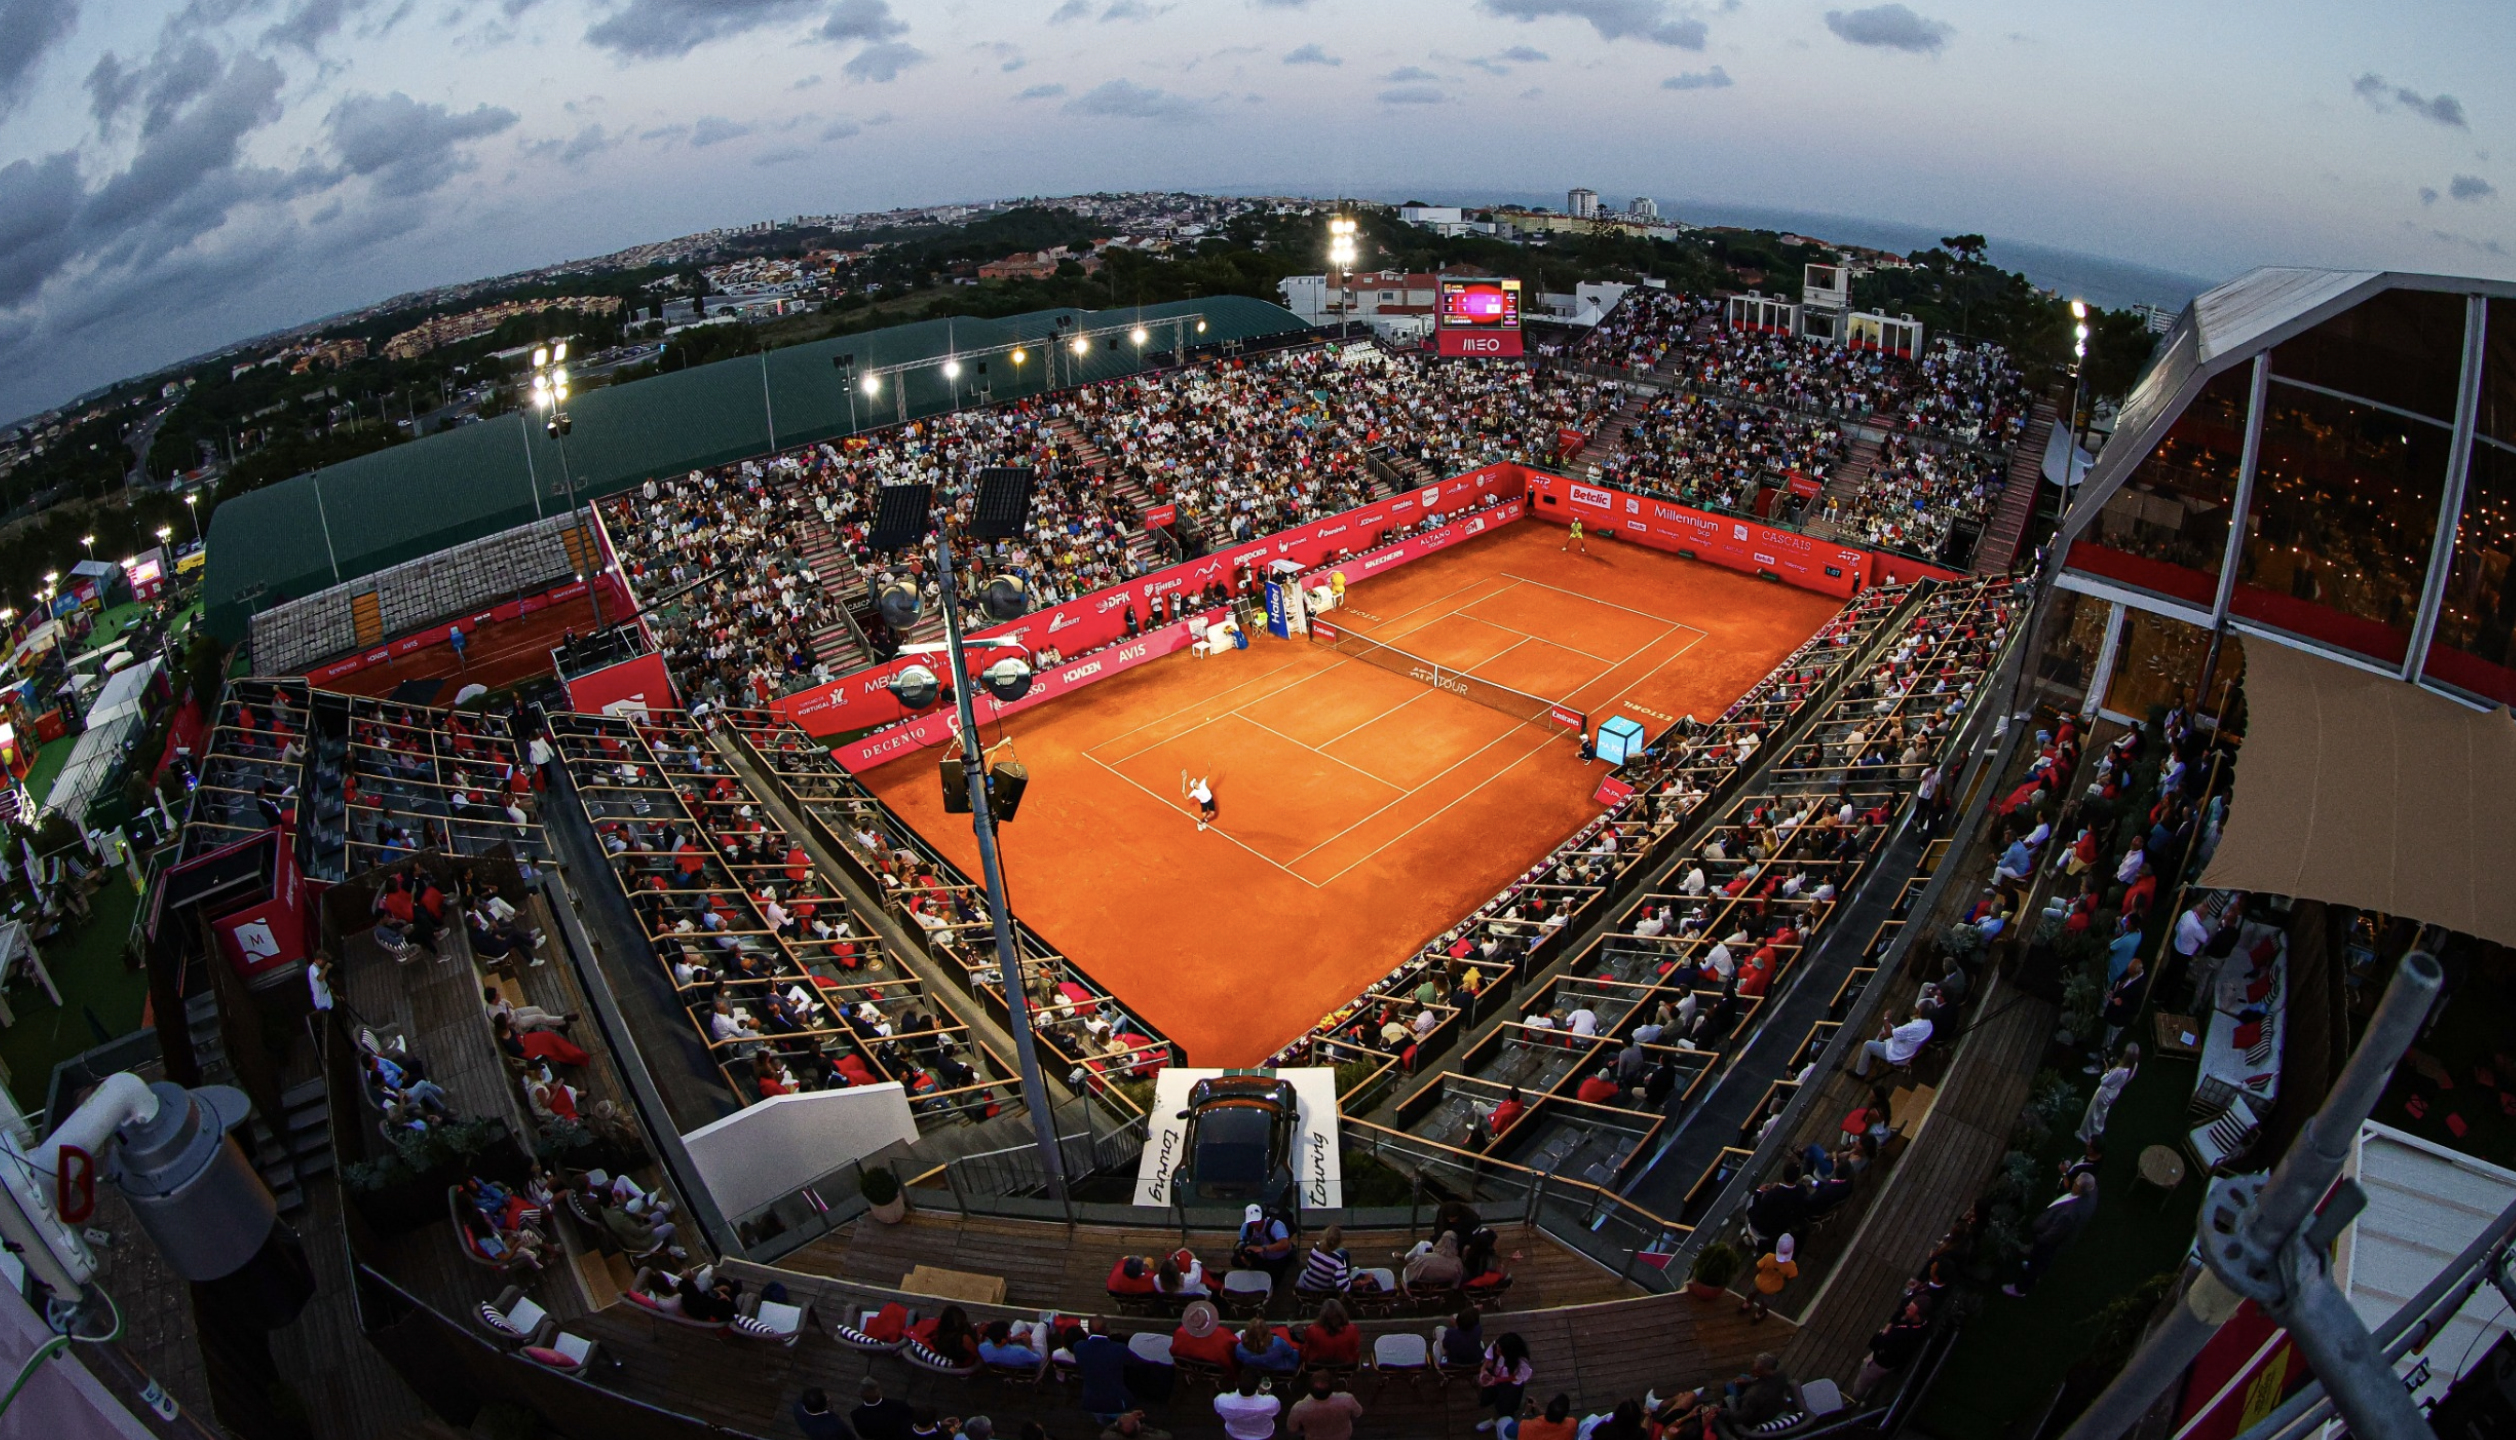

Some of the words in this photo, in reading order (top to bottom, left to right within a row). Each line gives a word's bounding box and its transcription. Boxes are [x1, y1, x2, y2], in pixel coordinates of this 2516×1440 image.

[1463, 338, 1500, 351] MEO
[1573, 489, 1608, 505] Betclic
[1654, 504, 1719, 532] Millennium
[1420, 530, 1451, 546] ALTANO
[1697, 528, 1711, 538] bcp
[1762, 531, 1812, 551] CASCAIS
[1364, 549, 1404, 569] SKECHERS
[1837, 550, 1861, 562] ATP
[1826, 567, 1840, 576] 1:07
[1155, 578, 1182, 592] SHIELD
[1108, 591, 1131, 606] DFK
[1271, 588, 1280, 624] Haier
[1119, 643, 1146, 663] AVIS
[1062, 661, 1102, 683] HOWDEN
[1438, 675, 1469, 696] TOUR
[798, 701, 830, 716] PORTUGAL
[1552, 709, 1580, 727] Emirates
[1623, 700, 1674, 722] ESTORIL
[862, 727, 926, 760] DECENIO
[249, 933, 265, 948] M
[1149, 1128, 1179, 1204] touring
[1309, 1131, 1329, 1208] touring
